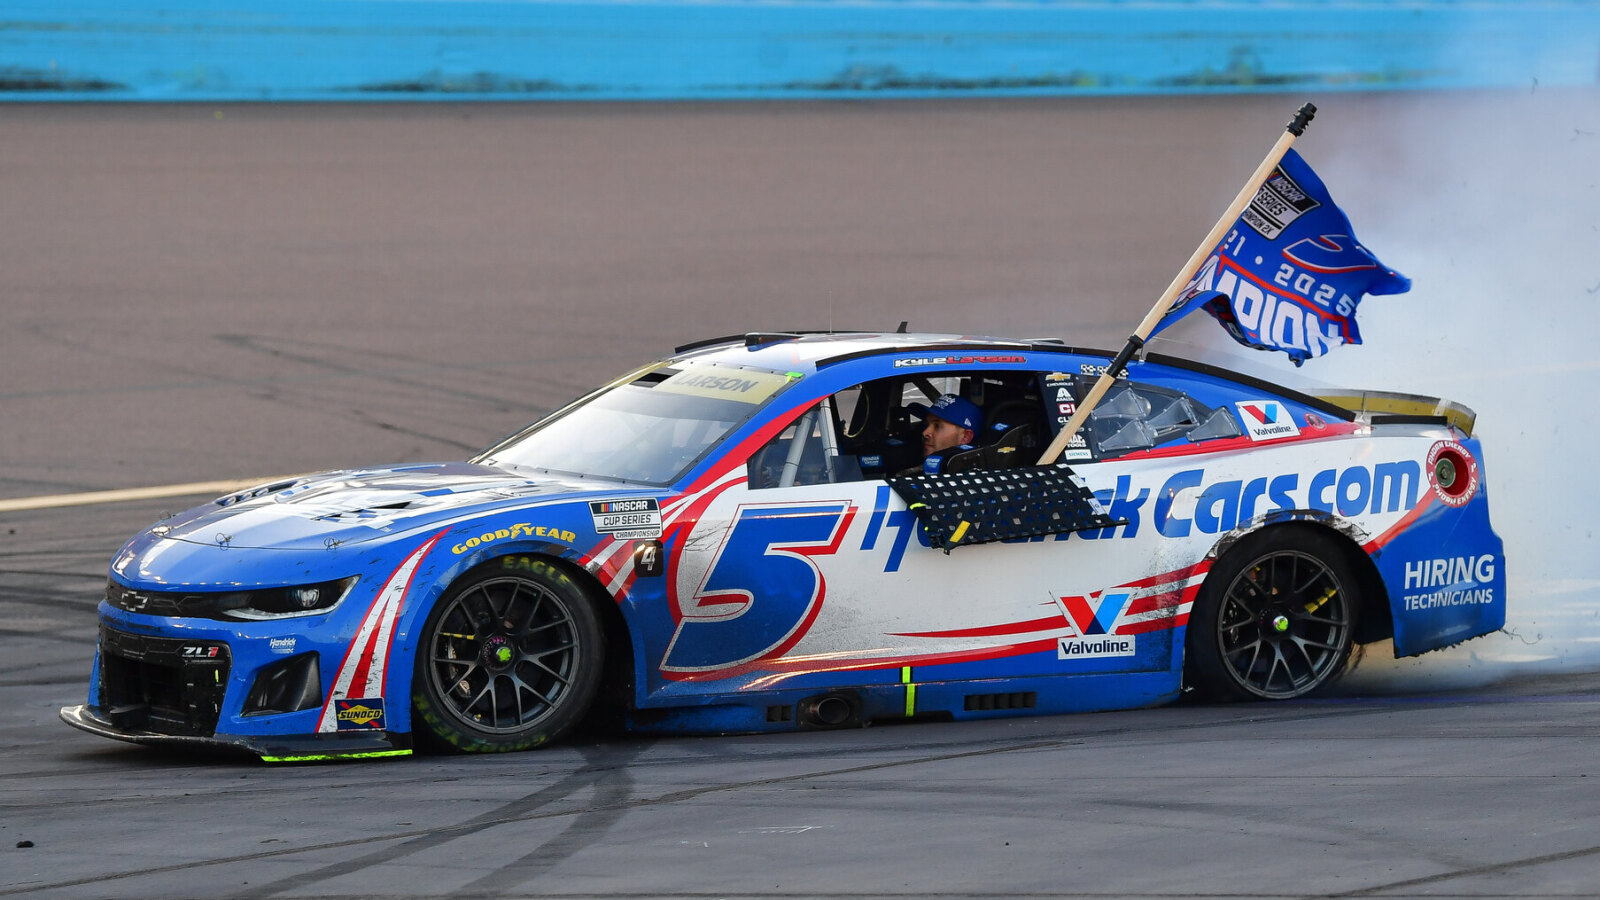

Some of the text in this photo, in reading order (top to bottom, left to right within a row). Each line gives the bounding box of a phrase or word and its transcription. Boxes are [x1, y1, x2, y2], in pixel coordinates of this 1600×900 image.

[1269, 176, 1306, 203] NASCAR
[1256, 191, 1288, 216] SERIES
[1261, 223, 1275, 235] 2X
[1273, 263, 1355, 317] 2025
[672, 375, 759, 393] LARSON
[1253, 425, 1292, 436] Valvoline
[612, 501, 648, 511] NASCAR
[603, 514, 652, 526] CUP SERIES
[451, 523, 576, 555] GOODYEAR
[615, 530, 660, 538] CHAMPIONSHIP
[640, 546, 657, 571] 4
[502, 555, 572, 585] EAGLE
[1404, 553, 1495, 590] HIRING
[659, 499, 859, 682] 5
[1403, 588, 1493, 611] TECHNICIANS
[182, 646, 219, 658] ZL1
[269, 638, 297, 649] Hendrick
[1061, 639, 1130, 655] Valvoline
[339, 710, 381, 719] SUNOCO
